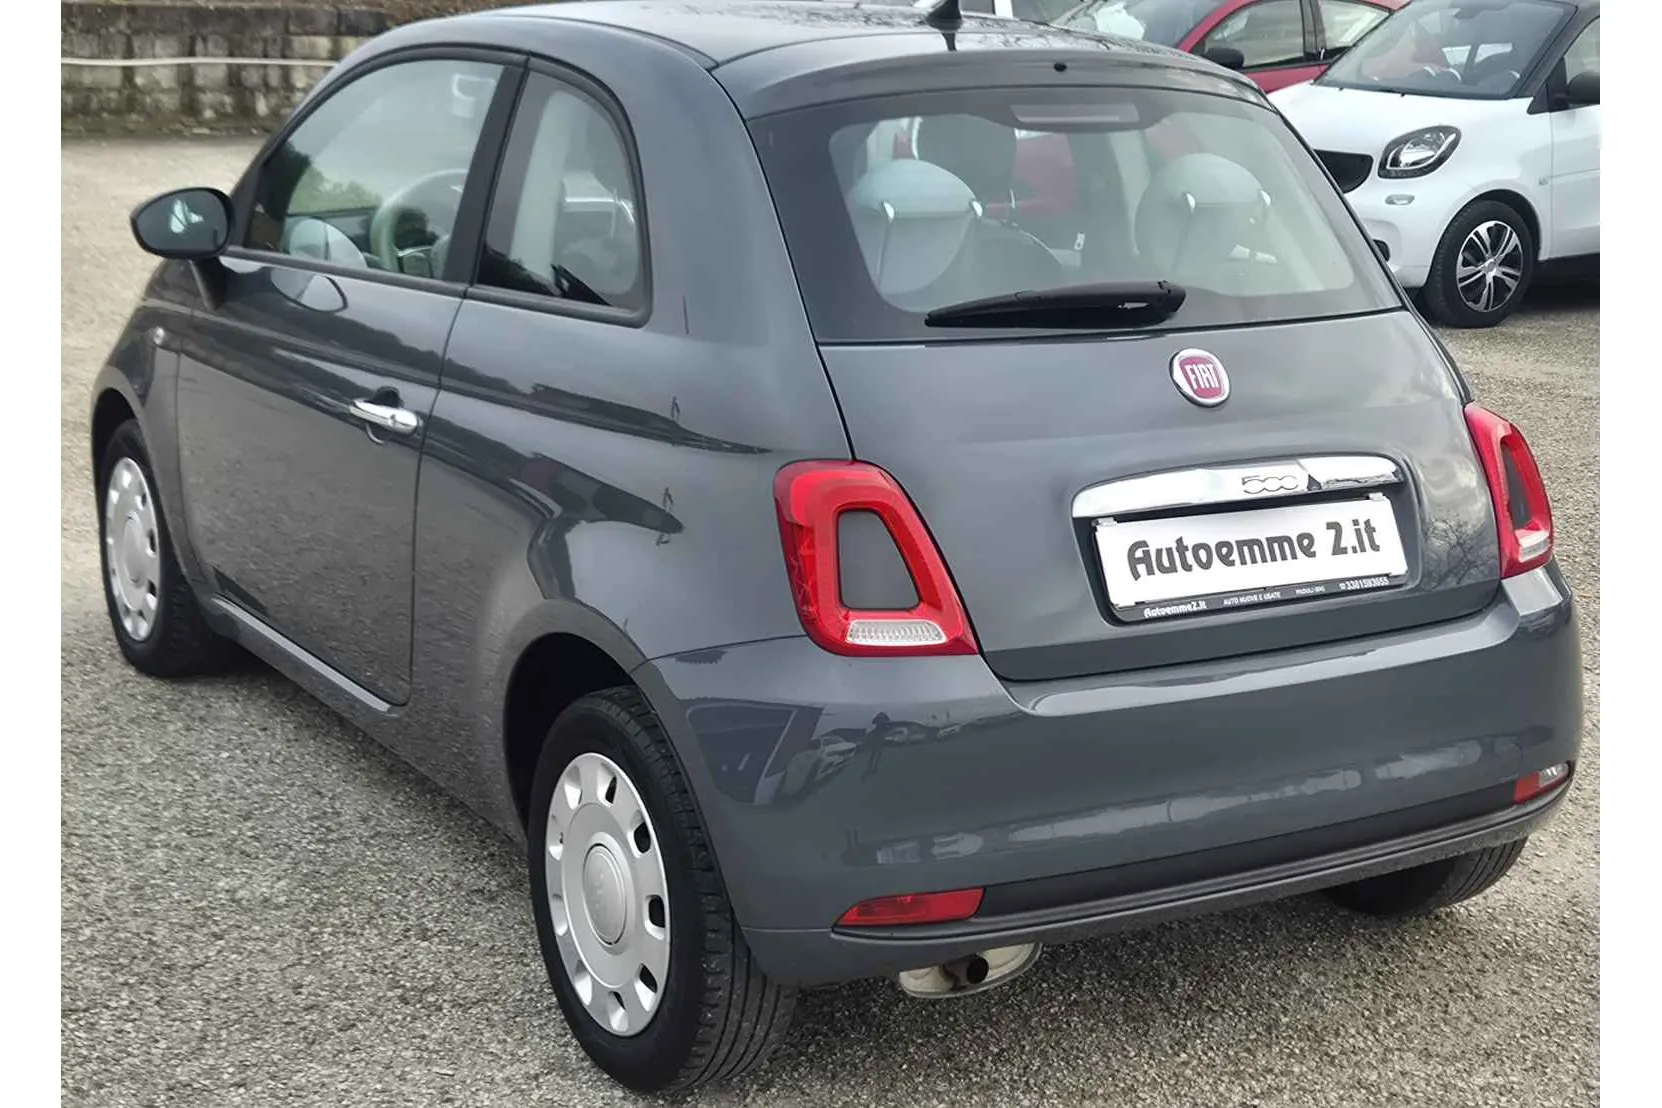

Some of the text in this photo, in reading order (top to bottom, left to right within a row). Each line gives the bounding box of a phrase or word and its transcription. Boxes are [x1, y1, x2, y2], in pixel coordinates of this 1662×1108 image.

[1183, 363, 1220, 390] FIAT
[1241, 475, 1299, 495] 500
[1127, 518, 1381, 581] Autoemme 2.it
[1143, 601, 1208, 618] Autoemme2.it
